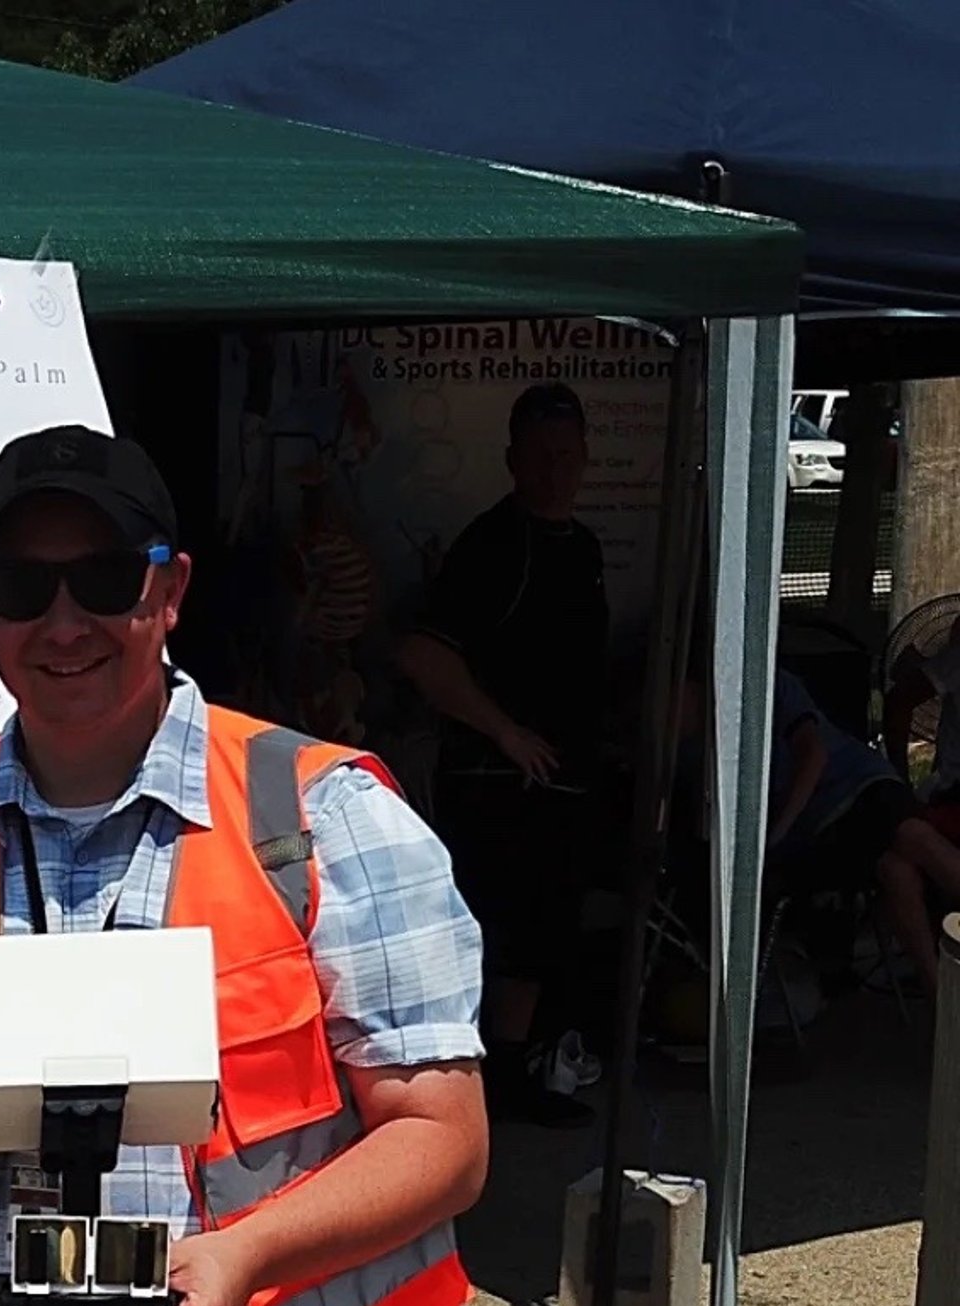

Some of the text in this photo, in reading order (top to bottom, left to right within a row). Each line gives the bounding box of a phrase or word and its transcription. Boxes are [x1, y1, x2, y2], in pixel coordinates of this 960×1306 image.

[396, 320, 516, 357] Spinal
[373, 355, 673, 384] & Sports Rehabilitation
